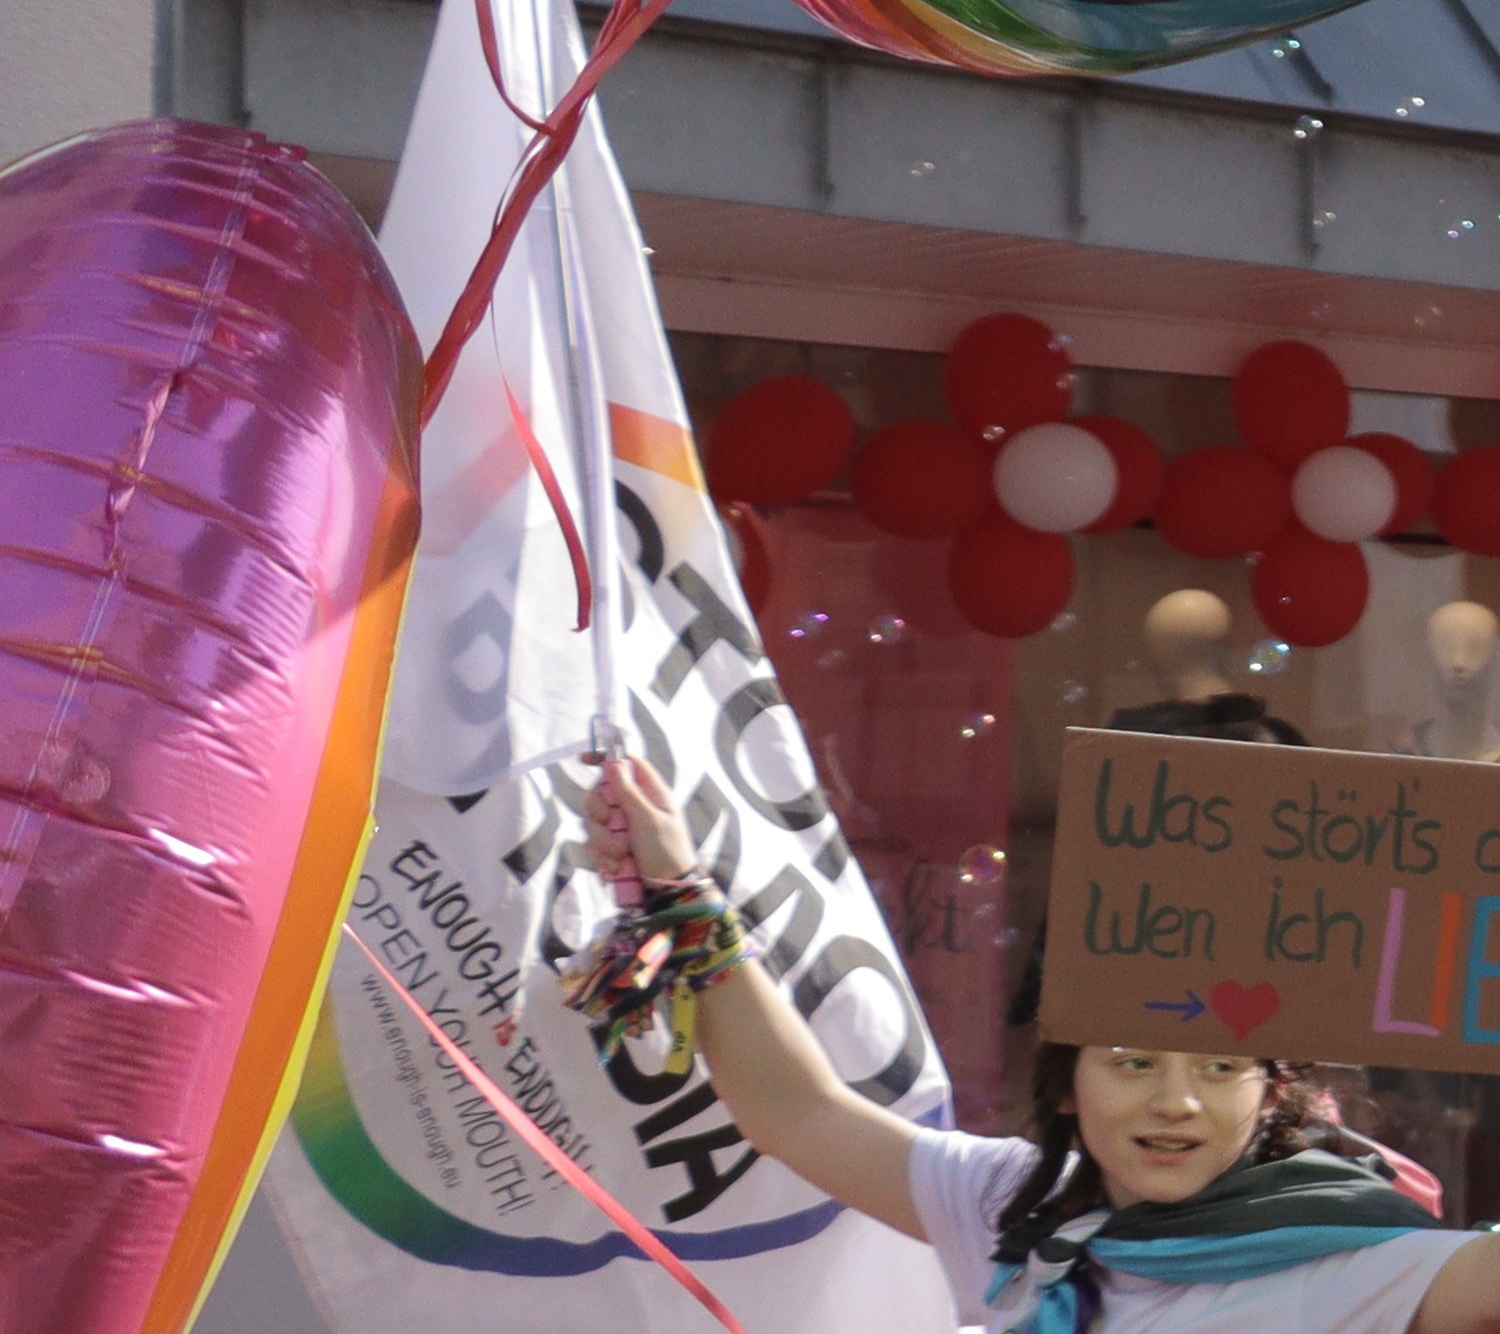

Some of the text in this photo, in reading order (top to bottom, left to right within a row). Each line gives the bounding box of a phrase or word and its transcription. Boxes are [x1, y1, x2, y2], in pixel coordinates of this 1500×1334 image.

[1095, 758, 1233, 853] Was
[390, 840, 519, 1019] ENOUGH
[1083, 881, 1217, 961] Wen
[1267, 877, 1364, 967] ich
[352, 871, 532, 1218] OPEN YOUR MOUTH!
[362, 972, 462, 1190] www.enough-is-enough.eu
